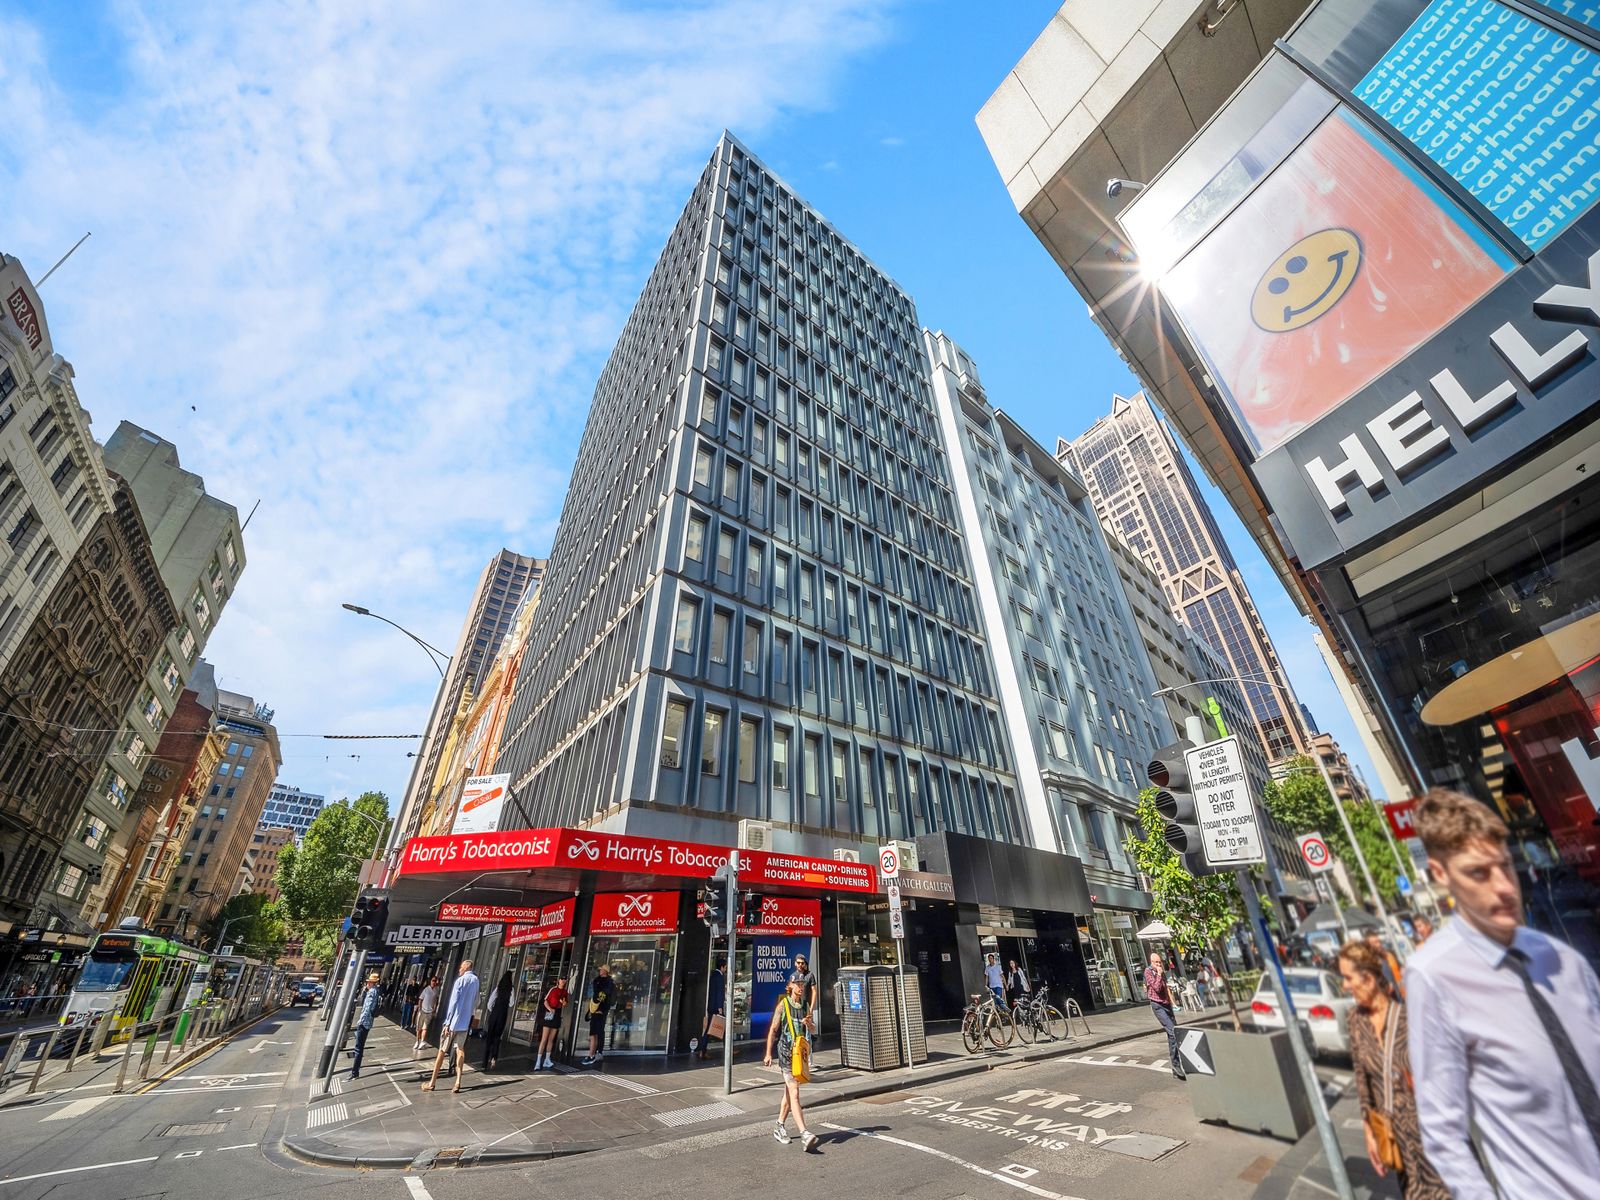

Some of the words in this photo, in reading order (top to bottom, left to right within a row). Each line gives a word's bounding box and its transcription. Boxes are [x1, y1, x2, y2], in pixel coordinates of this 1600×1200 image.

[1198, 746, 1224, 759] VEHICLES
[1200, 759, 1215, 769] OVER
[1202, 771, 1207, 779] IN
[1208, 765, 1230, 777] LENGTH
[478, 777, 493, 785] SALE
[1194, 778, 1218, 790] WITHOUT
[1218, 772, 1243, 785] PERMITS
[1208, 793, 1219, 803] DO
[1220, 789, 1234, 801] NOT
[1212, 801, 1235, 814] ENTER
[1222, 818, 1230, 827] TO
[1227, 837, 1237, 847] TO
[409, 841, 457, 865] Harry's
[462, 836, 551, 859] Tobacconist
[605, 839, 663, 867] Harry's
[667, 846, 752, 871] Tobaccost
[1229, 848, 1238, 856] SAT
[1306, 844, 1325, 860] 20
[766, 857, 809, 870] AMERICAN
[811, 861, 838, 873] CANDY
[840, 866, 868, 877] DRINKS
[883, 856, 894, 868] 20
[764, 868, 801, 881] HOOKAH
[828, 876, 869, 888] SOUVENIRS
[922, 880, 952, 893] GALLERY
[460, 905, 489, 918] Harry's
[491, 906, 538, 917] Tobacconist
[601, 918, 624, 928] Harry's
[625, 917, 666, 927] Tobacconist
[761, 911, 814, 927] Tobacconist
[402, 928, 460, 940] LERROI
[757, 945, 770, 957] RED
[771, 946, 787, 957] BULL
[757, 959, 776, 970] GIVES
[777, 958, 791, 969] YOU
[904, 1096, 1019, 1122] GIVE
[1013, 1114, 1137, 1143] WAY
[903, 1107, 929, 1115] TO
[928, 1112, 1071, 1151] PEDESTRIANS
